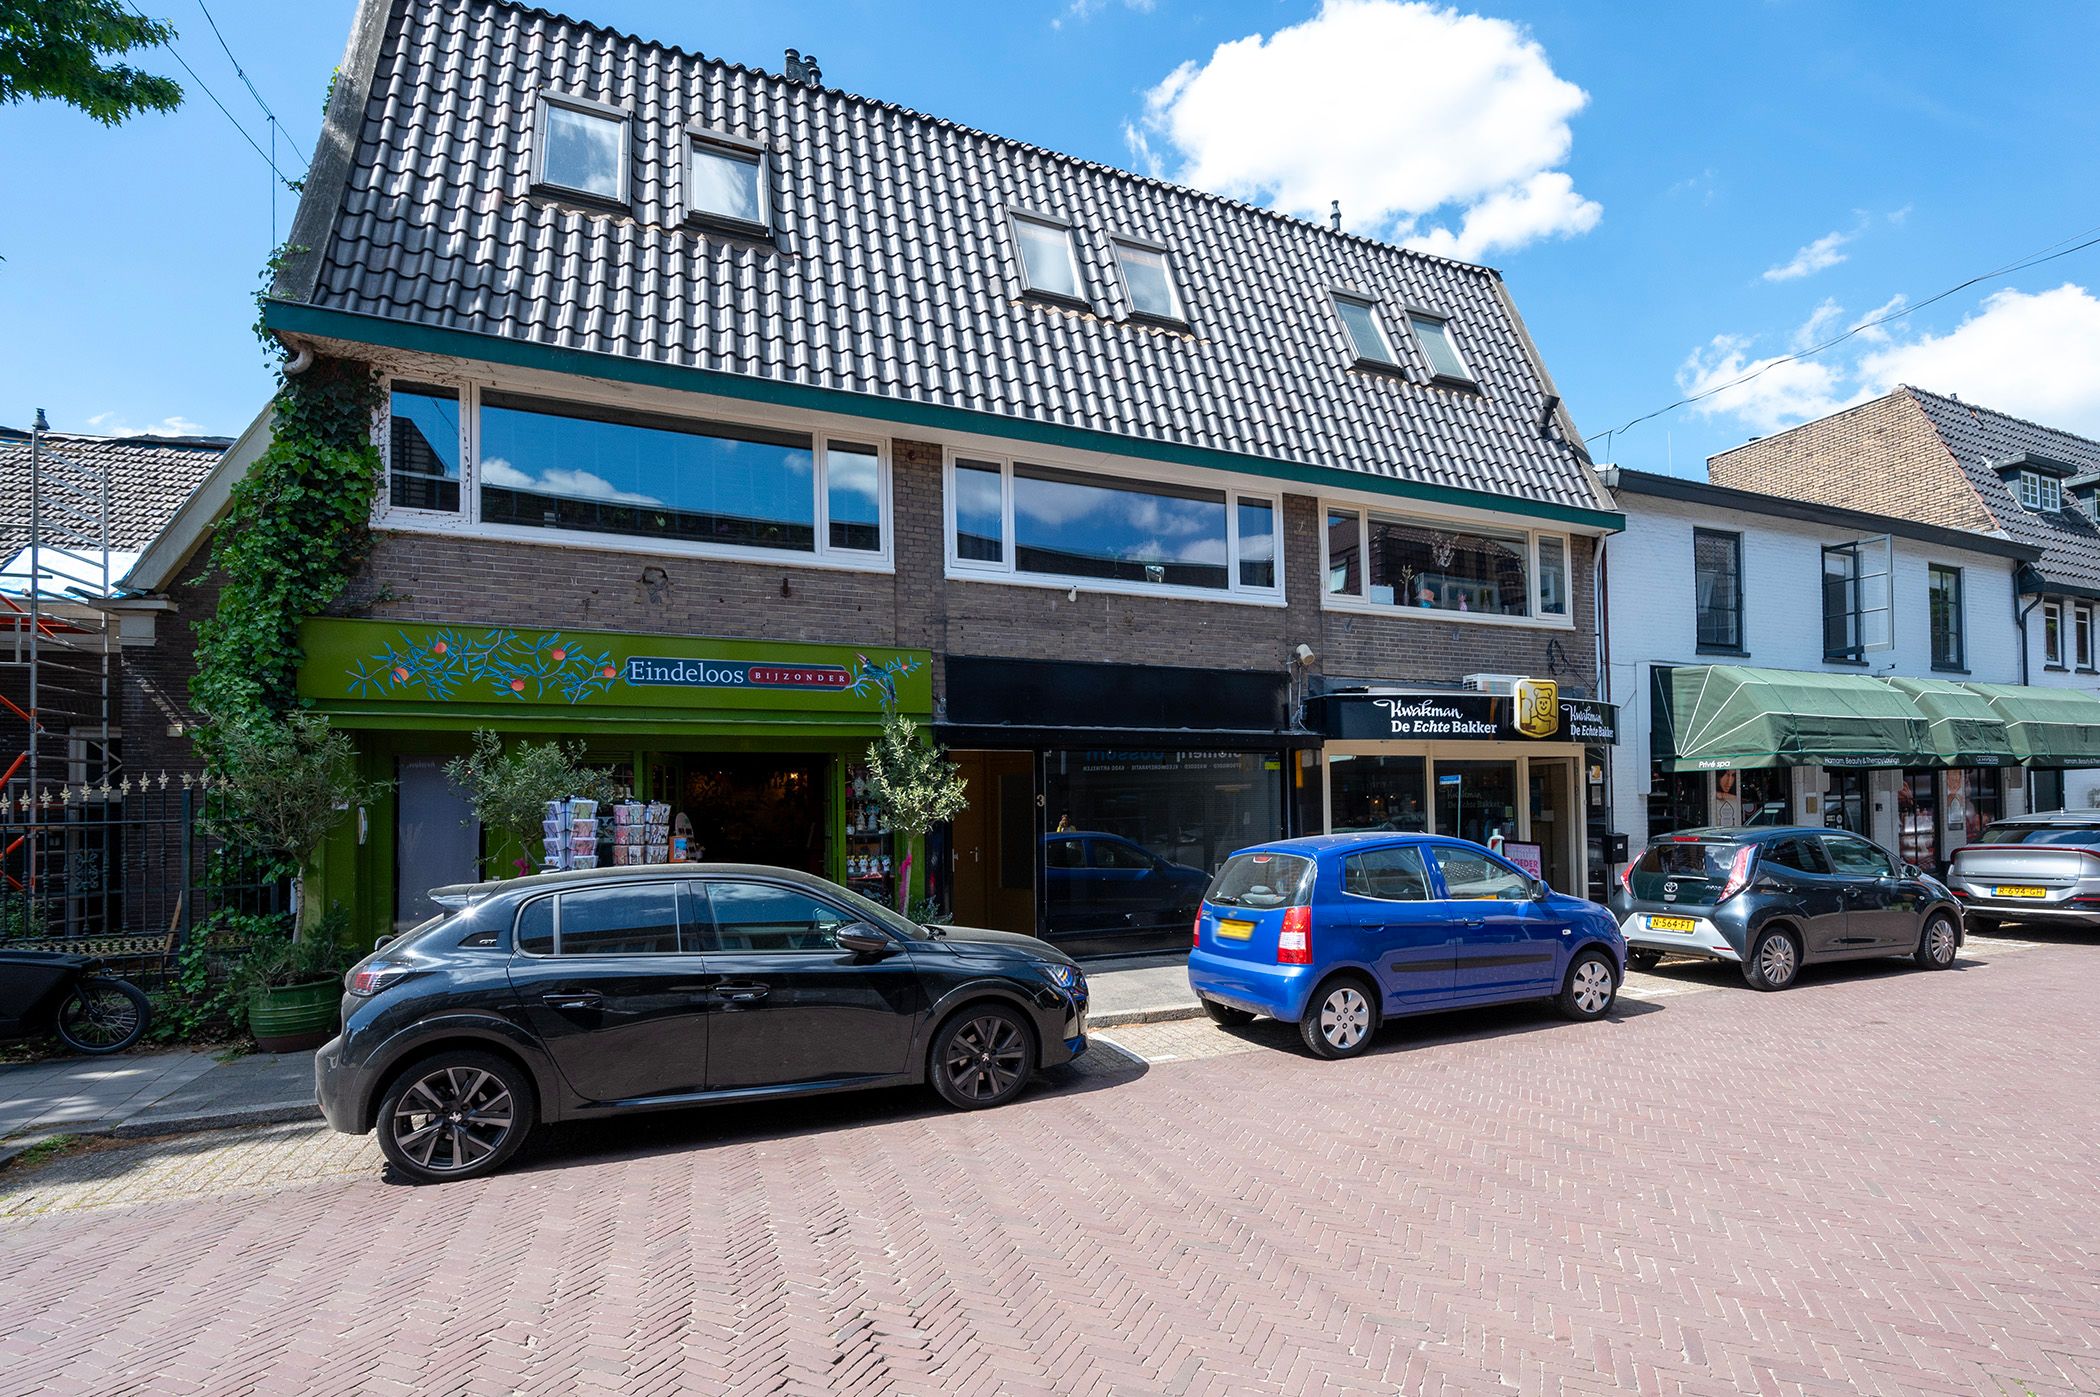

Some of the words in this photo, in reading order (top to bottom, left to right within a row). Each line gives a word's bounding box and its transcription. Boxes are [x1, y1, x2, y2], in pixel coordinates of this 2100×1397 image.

[630, 660, 744, 684] Eindeloos
[755, 671, 845, 683] BIJZONDER
[1373, 699, 1463, 719] Kwakman
[1560, 703, 1602, 725] Kwakman
[1391, 720, 1410, 733] De
[1412, 720, 1450, 733] Echte
[1452, 720, 1498, 734] Bakker
[1570, 724, 1581, 736] De
[1581, 724, 1598, 736] Echte
[1598, 725, 1614, 738] Bakker
[1698, 759, 1716, 768] Privé
[1716, 760, 1731, 768] spa
[1036, 794, 1045, 806] 3
[1652, 917, 1691, 930] N-564-FT
